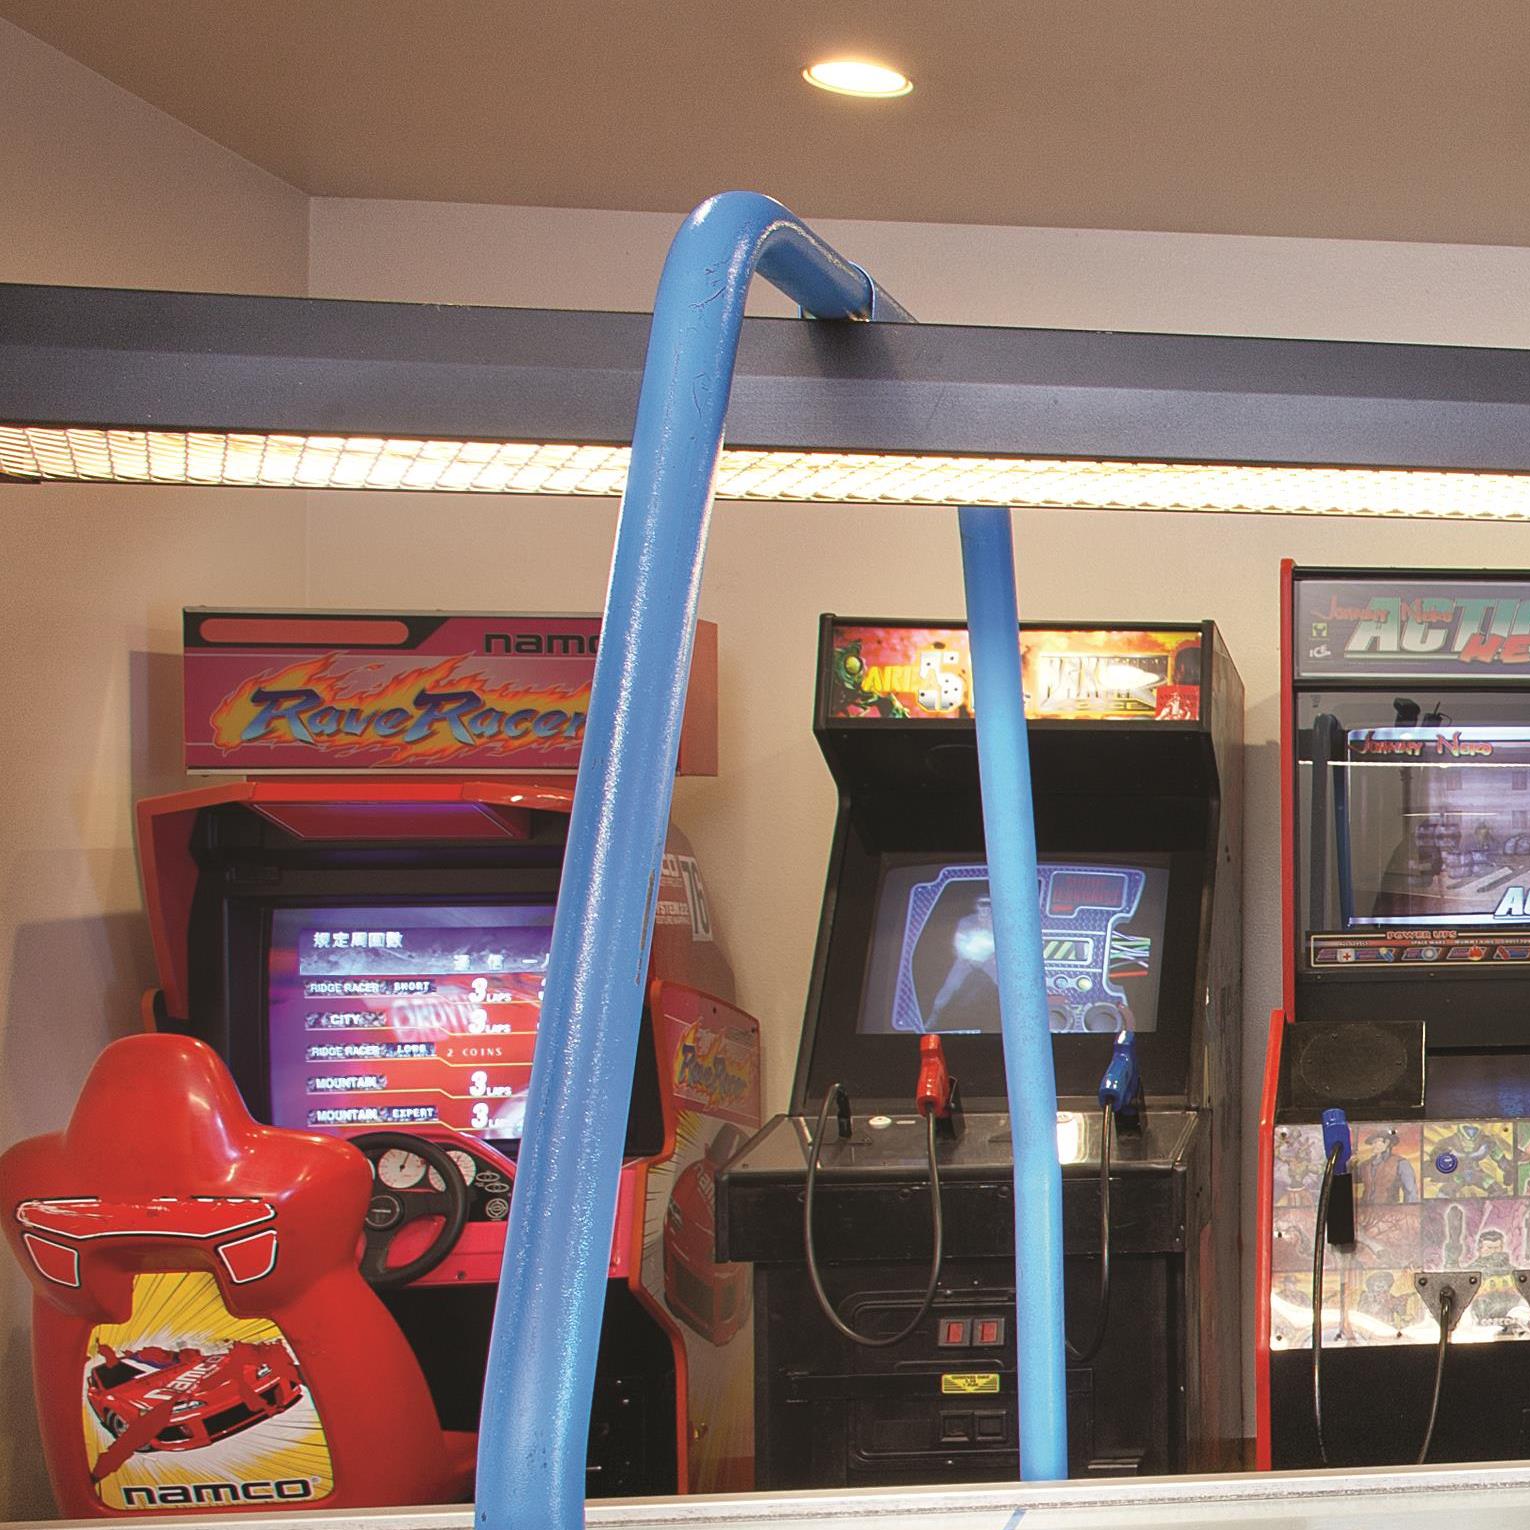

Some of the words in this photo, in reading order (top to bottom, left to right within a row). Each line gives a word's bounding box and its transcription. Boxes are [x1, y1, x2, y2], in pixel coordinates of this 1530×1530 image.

[240, 687, 412, 744] Rave
[310, 983, 341, 993] RIDGE
[344, 983, 380, 993] RACER
[468, 978, 488, 1003] 3
[331, 1015, 361, 1025] CITY
[311, 1047, 342, 1057] RIDGE
[463, 1048, 502, 1057] COINS
[316, 1077, 377, 1089] MOUNTAIN
[469, 1071, 488, 1097] 3
[317, 1109, 378, 1121] MOUNTAIN
[392, 1108, 434, 1119] EXPERT
[472, 1103, 488, 1128] 3
[144, 1354, 224, 1401] namco
[123, 1478, 312, 1505] namco
